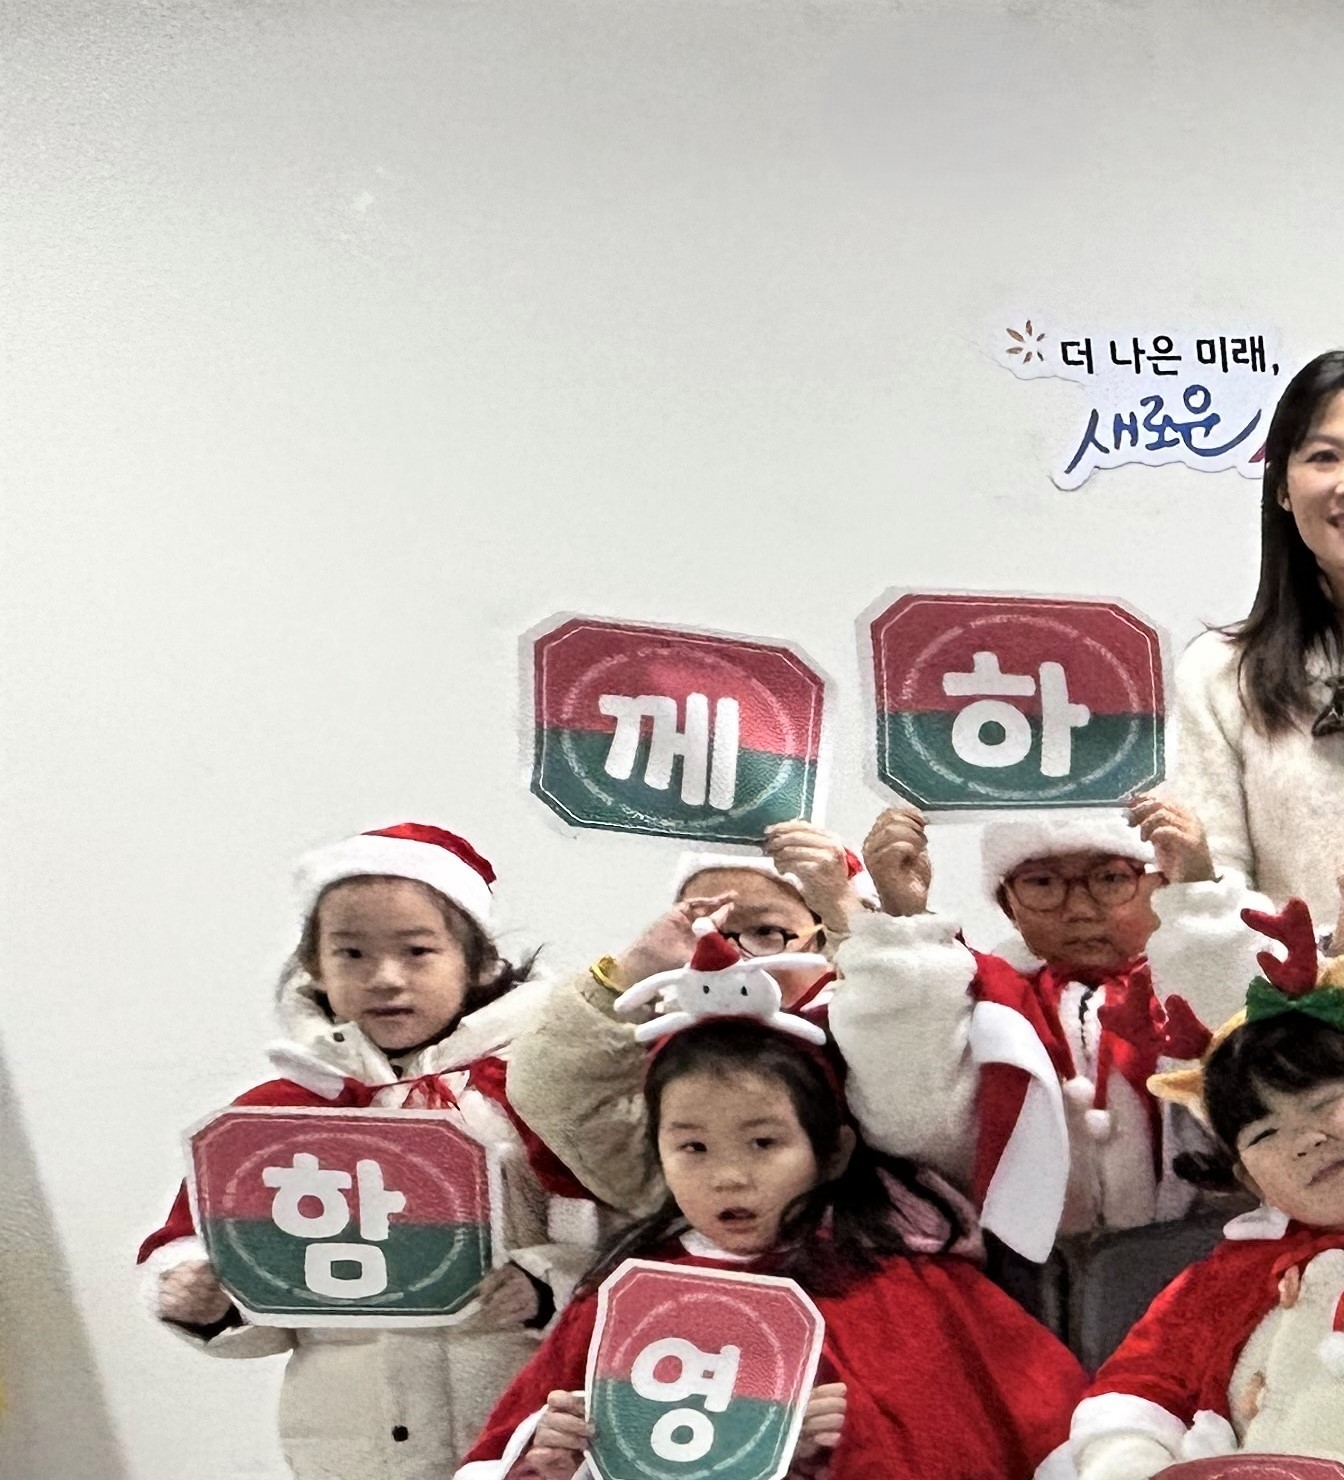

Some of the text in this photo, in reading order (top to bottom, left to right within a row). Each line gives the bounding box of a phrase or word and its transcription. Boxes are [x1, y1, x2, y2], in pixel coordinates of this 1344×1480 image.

[1060, 335, 1280, 376] 더 나은 미래,
[1064, 384, 1262, 473] 새로운
[598, 691, 741, 811] 께
[942, 651, 1091, 778] 하
[262, 1152, 407, 1299] 함
[630, 1337, 741, 1463] 영
